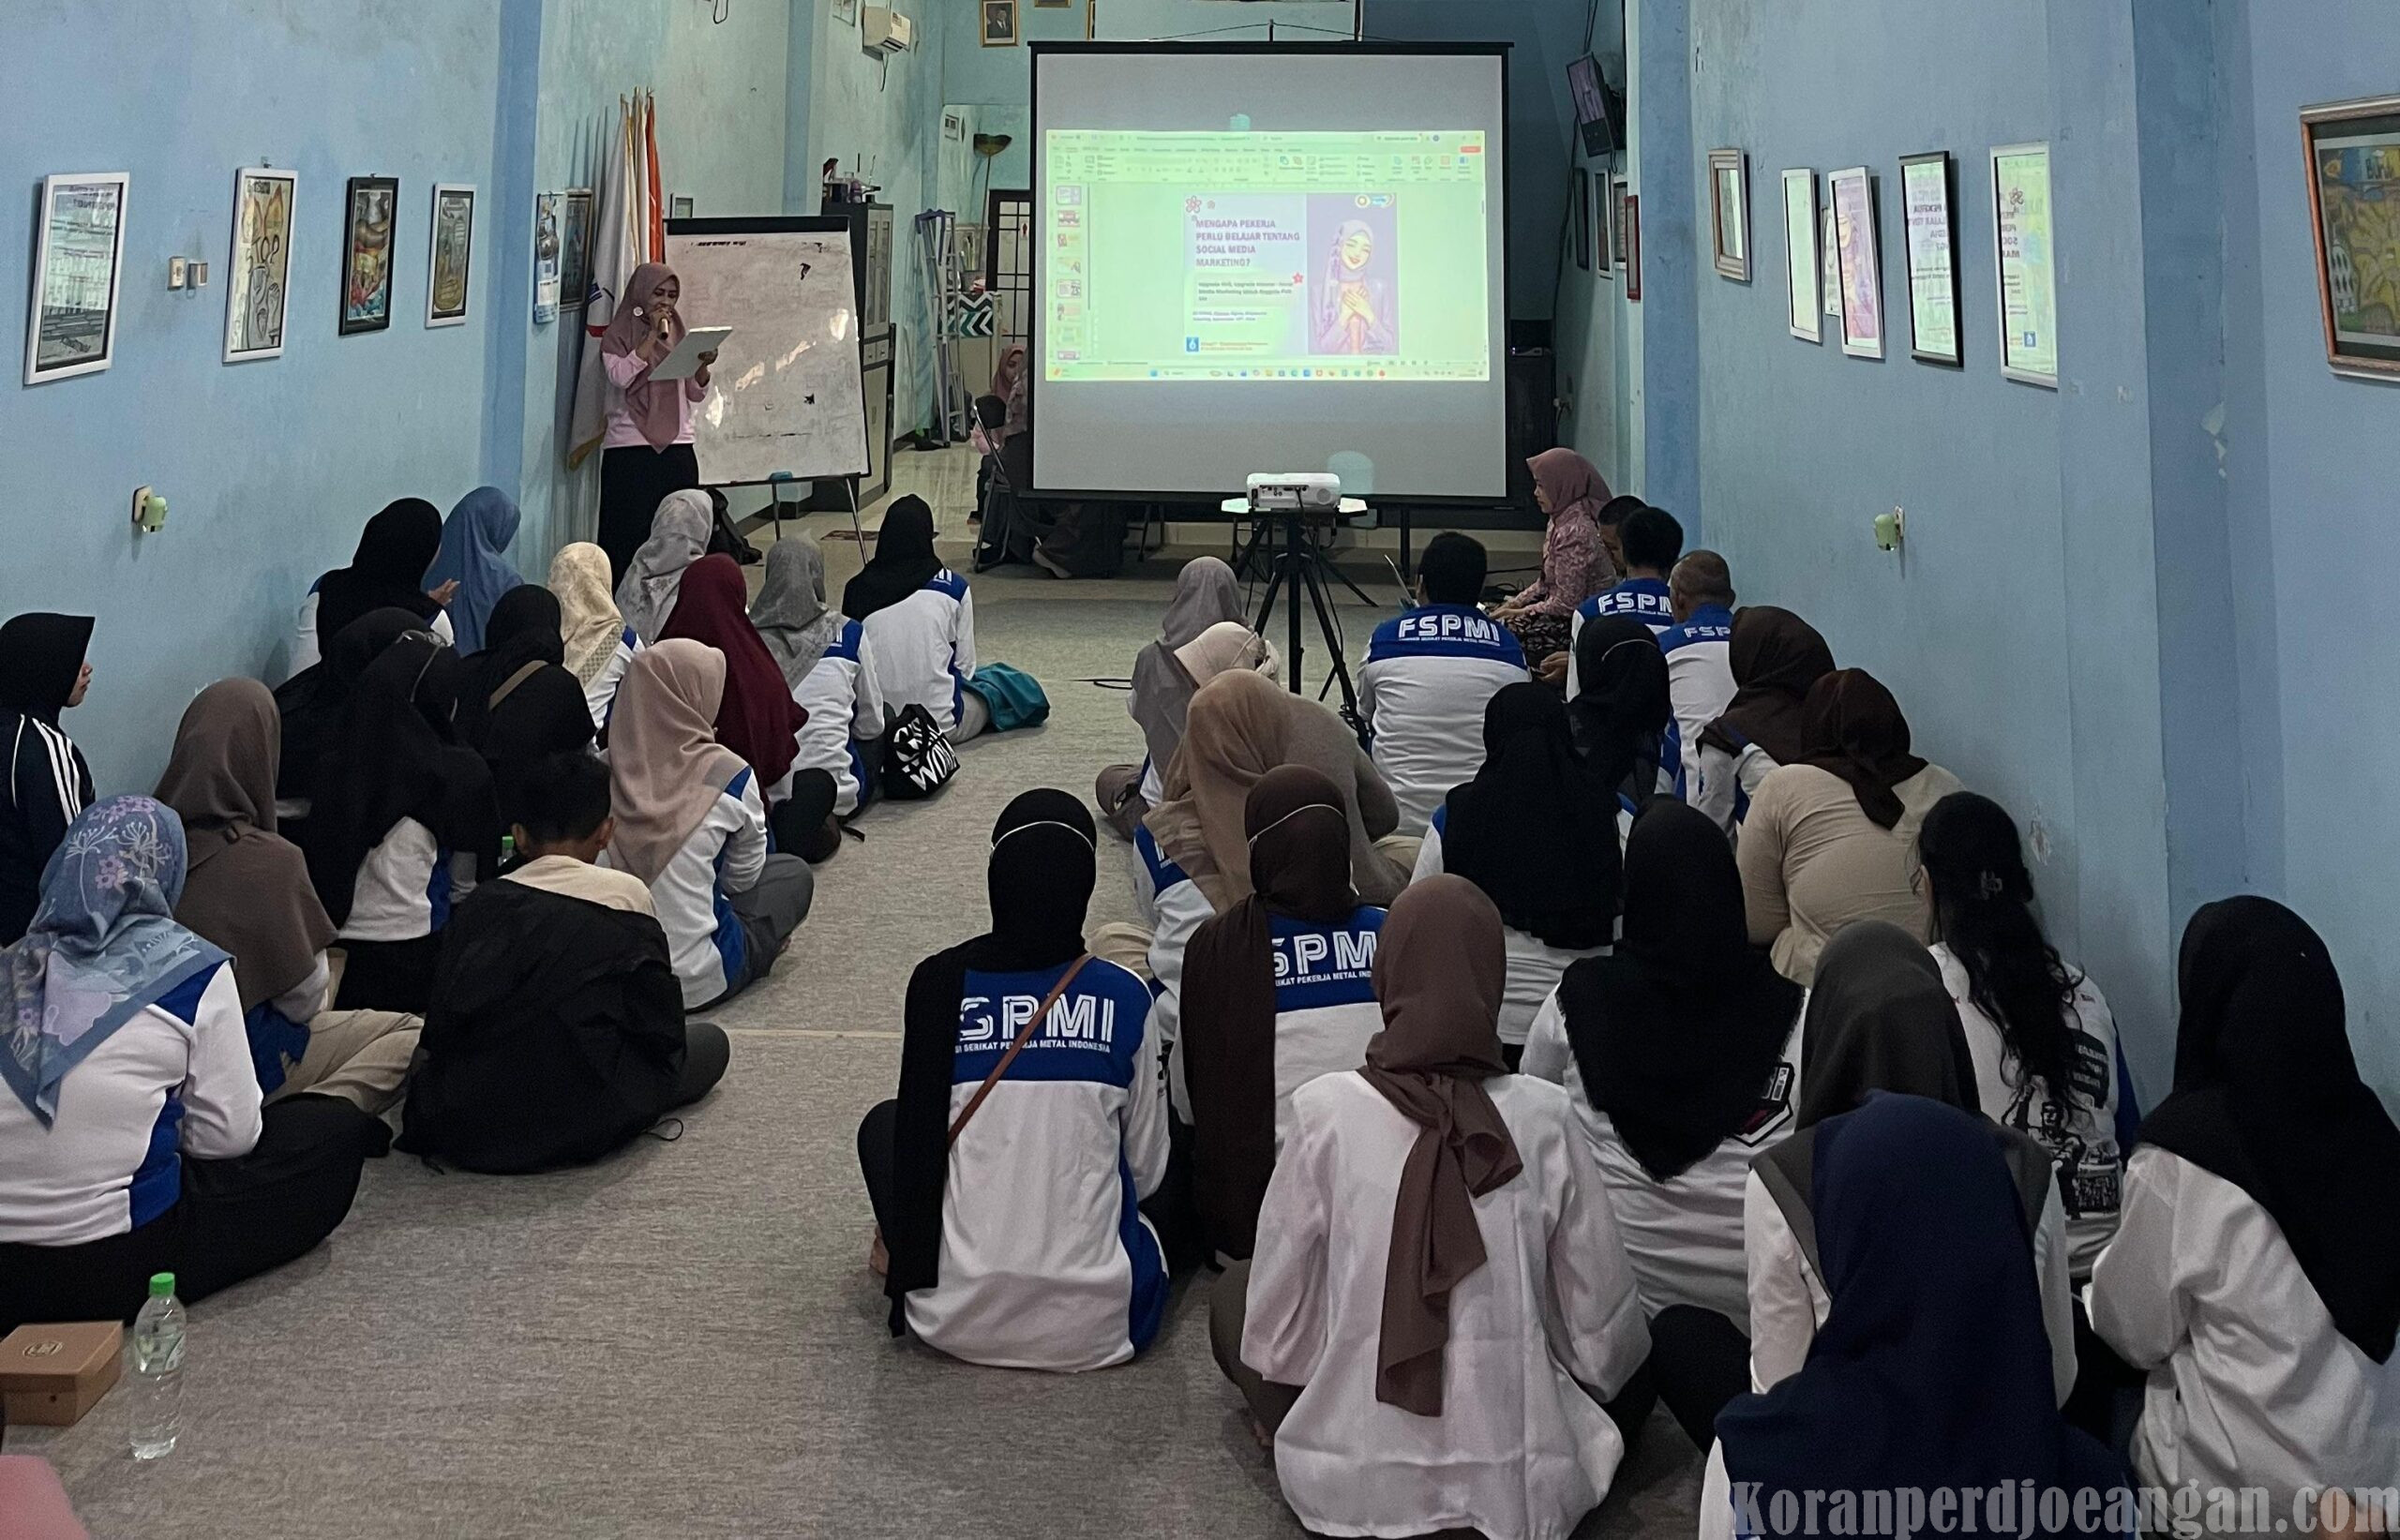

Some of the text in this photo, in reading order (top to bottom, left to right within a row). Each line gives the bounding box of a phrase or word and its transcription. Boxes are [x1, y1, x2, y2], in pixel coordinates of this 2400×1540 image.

[1195, 232, 1223, 241] PERLU
[1261, 232, 1300, 241] TENTANG
[1195, 246, 1256, 254] SOCIAL MEDIA
[1398, 614, 1500, 642] FSPMI
[1684, 625, 1732, 638] FSP
[1271, 931, 1377, 977] SPM
[1297, 974, 1331, 984] PEKERJA
[1332, 971, 1358, 980] METAL
[959, 994, 1115, 1042] SPMI
[964, 1041, 998, 1053] SERIKAT
[1040, 1039, 1067, 1049] METAL
[1069, 1039, 1111, 1054] INDONESIA
